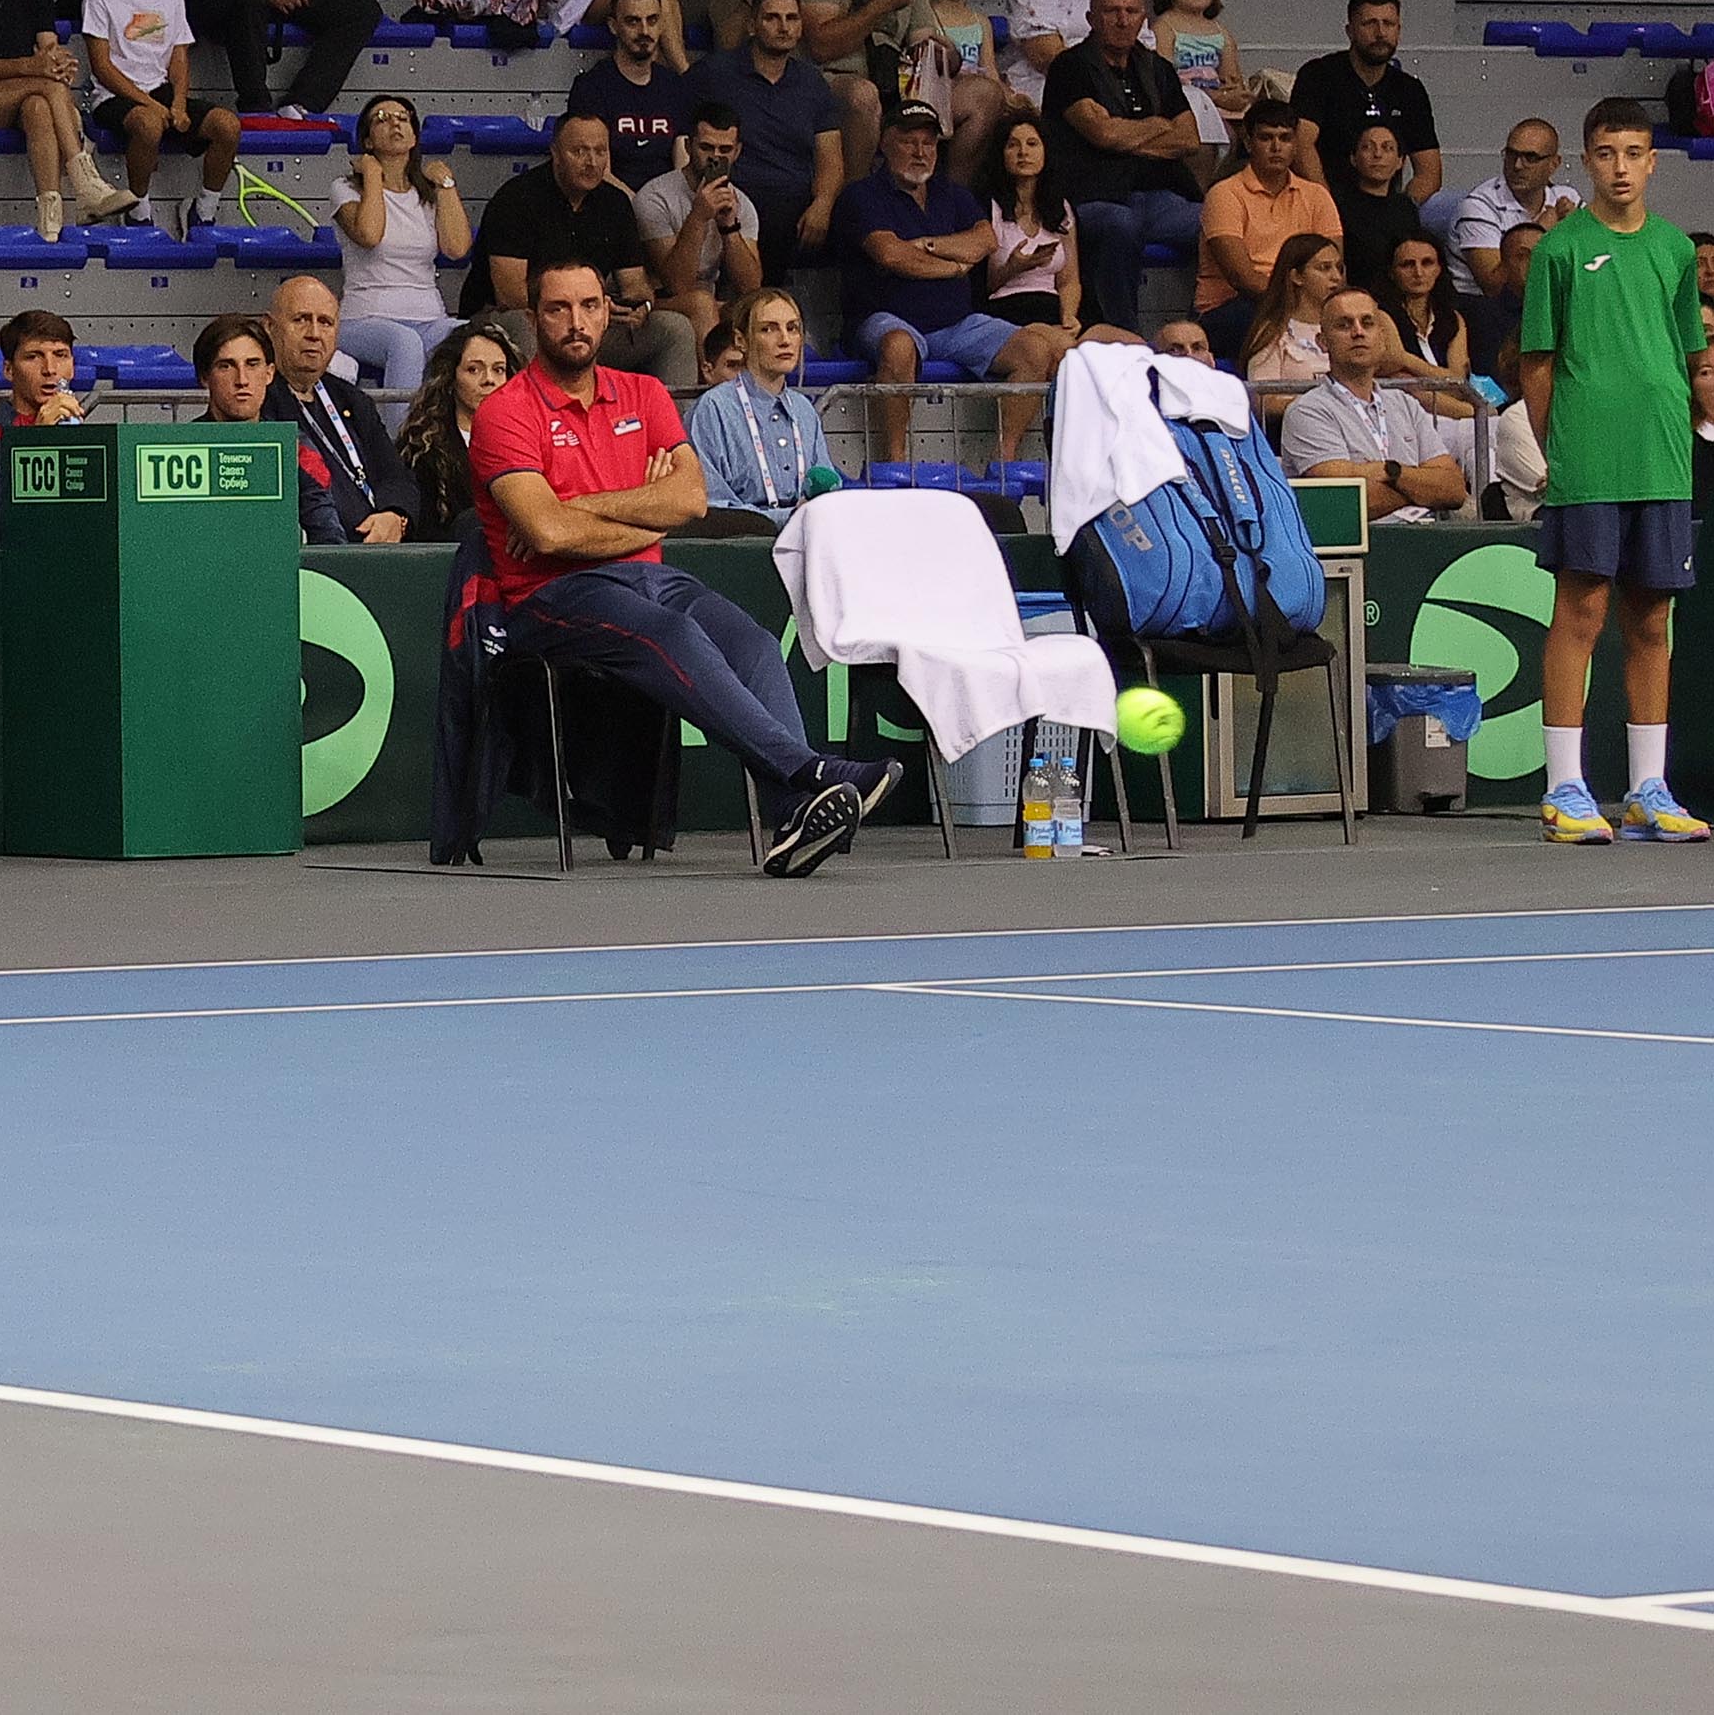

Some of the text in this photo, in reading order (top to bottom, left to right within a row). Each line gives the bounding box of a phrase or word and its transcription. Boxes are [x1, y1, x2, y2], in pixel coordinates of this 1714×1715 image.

[617, 117, 670, 134] AIR
[218, 452, 253, 464] Тениски
[218, 465, 245, 476] Савез
[218, 477, 249, 490] Србије
